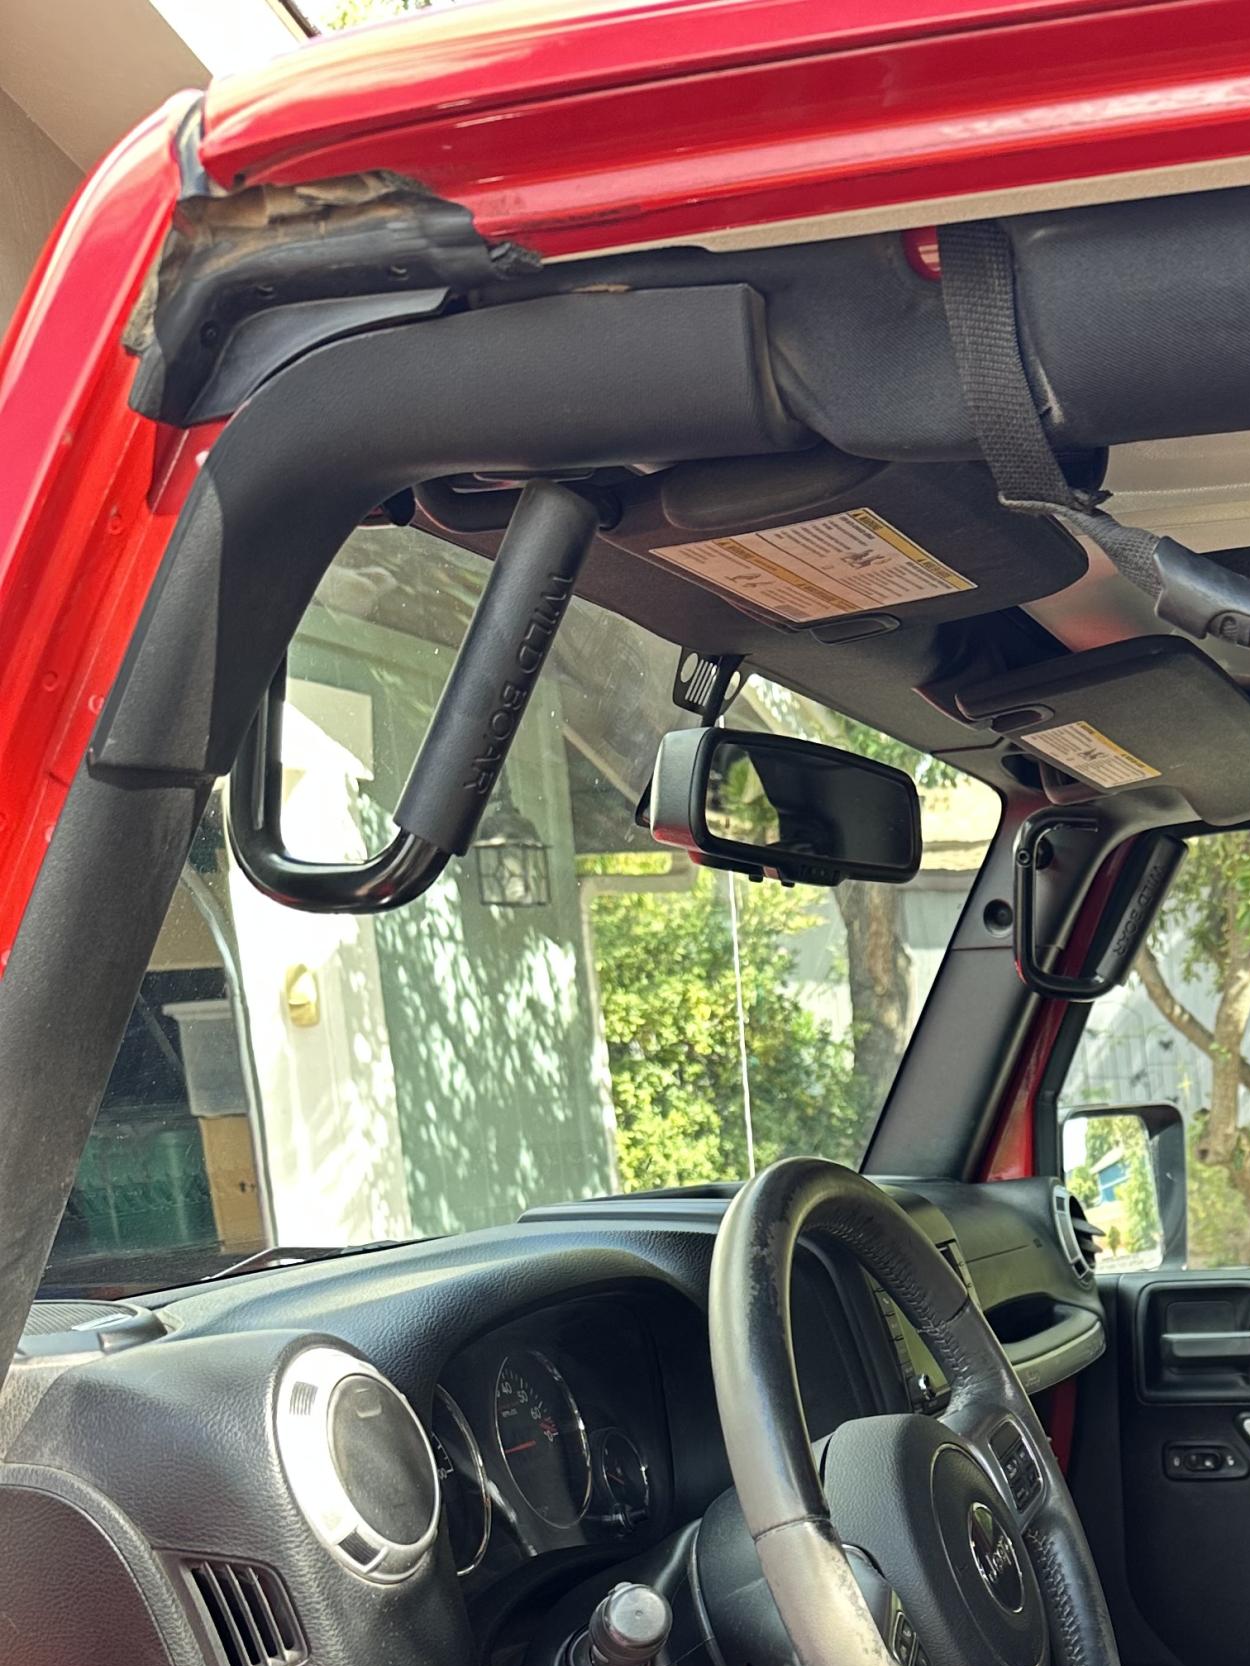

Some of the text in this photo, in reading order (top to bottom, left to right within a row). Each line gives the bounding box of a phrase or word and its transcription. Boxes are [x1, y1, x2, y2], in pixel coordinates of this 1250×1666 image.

[463, 573, 573, 794] WILD BOAR
[1113, 908, 1139, 956] BOAR
[985, 1535, 1012, 1583] Jeep
